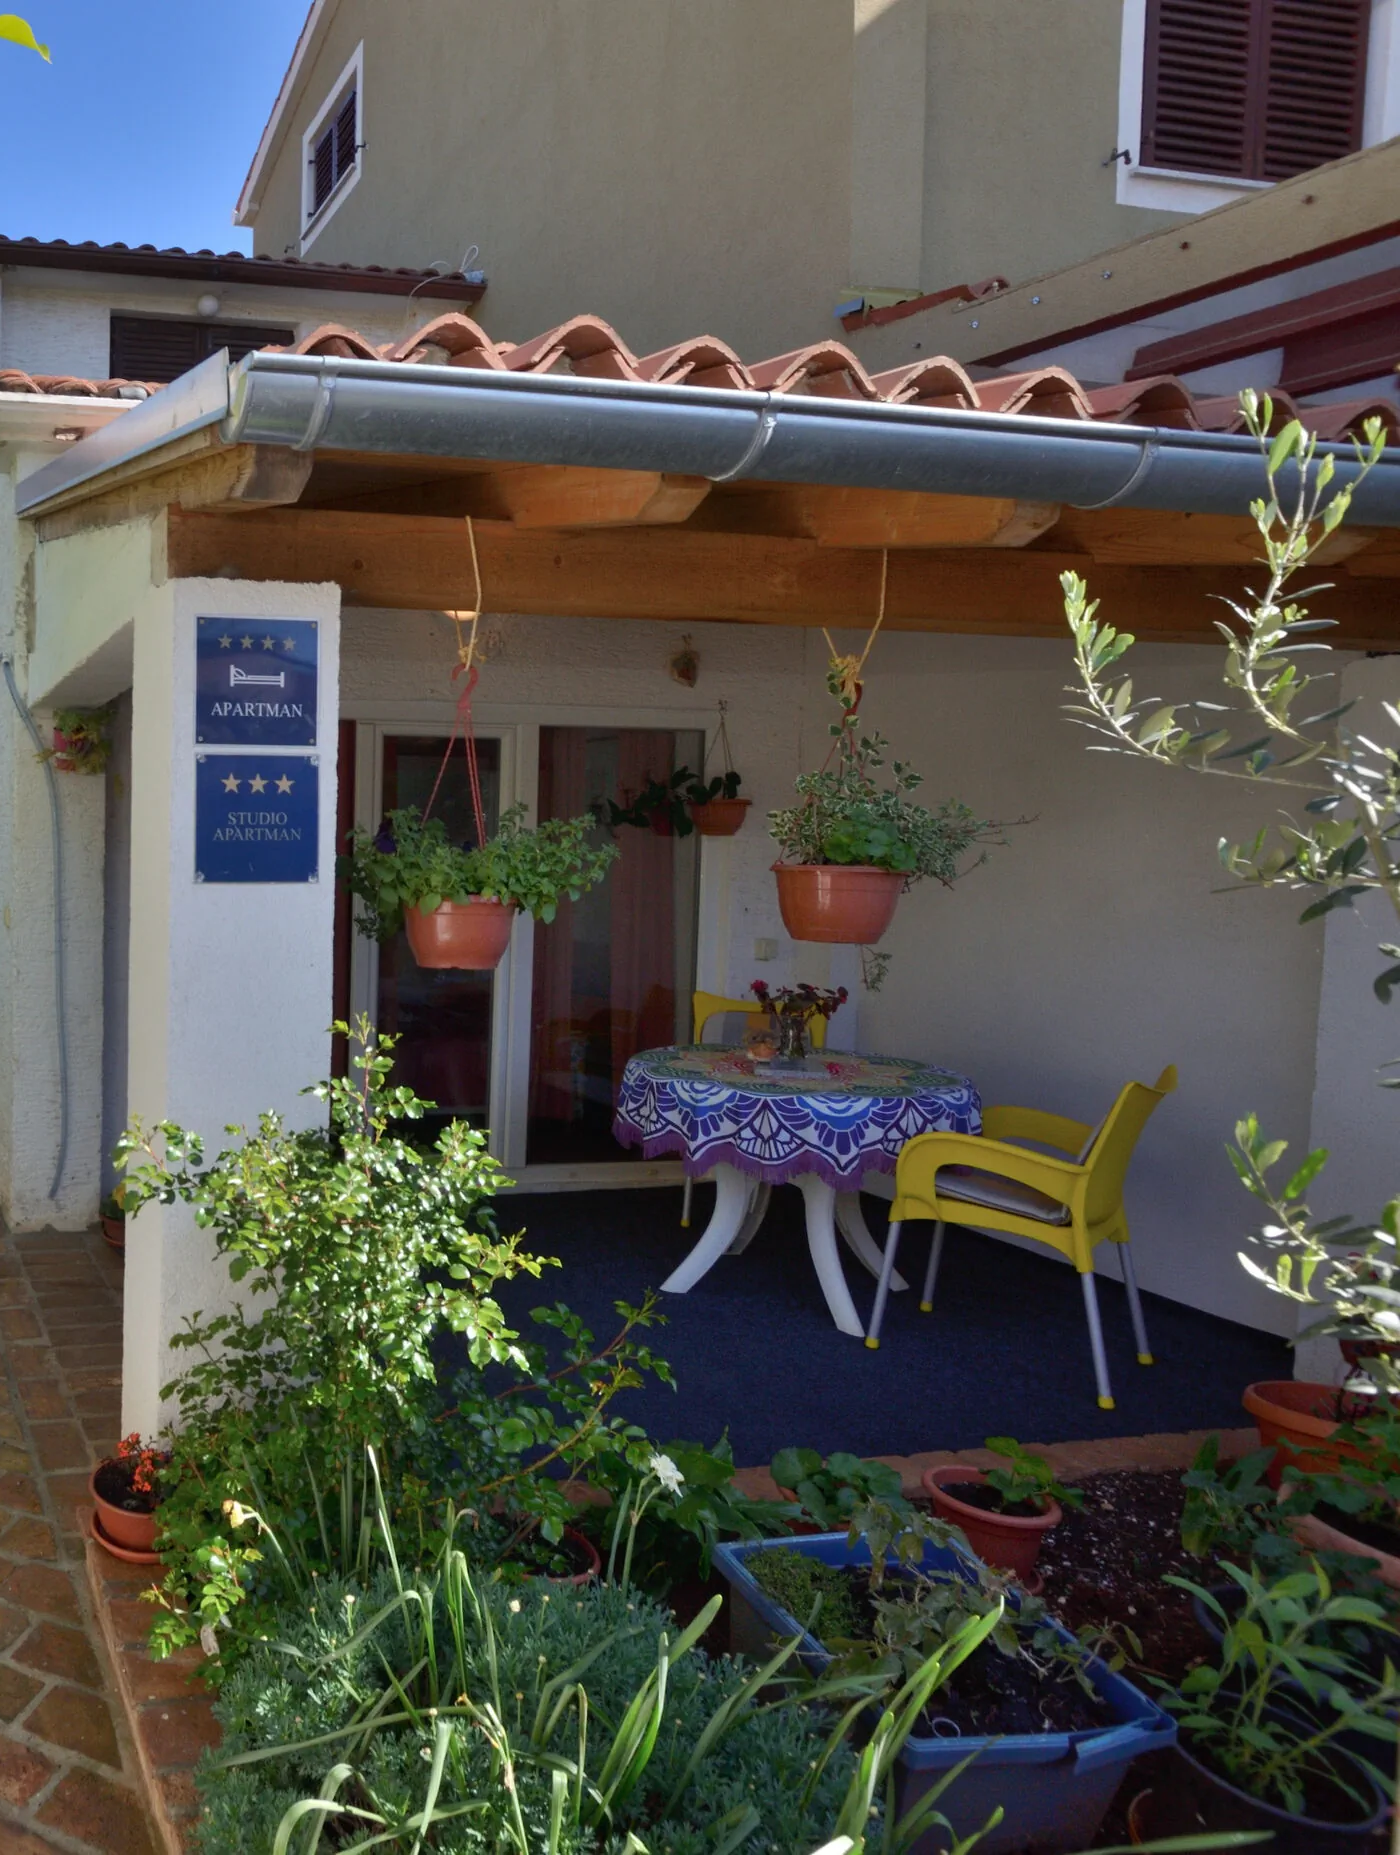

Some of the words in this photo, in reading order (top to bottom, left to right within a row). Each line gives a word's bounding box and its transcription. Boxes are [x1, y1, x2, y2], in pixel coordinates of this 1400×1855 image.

[211, 702, 302, 717] APARTMAN
[228, 811, 287, 825] STUDIO
[213, 827, 301, 841] APARTMAN
